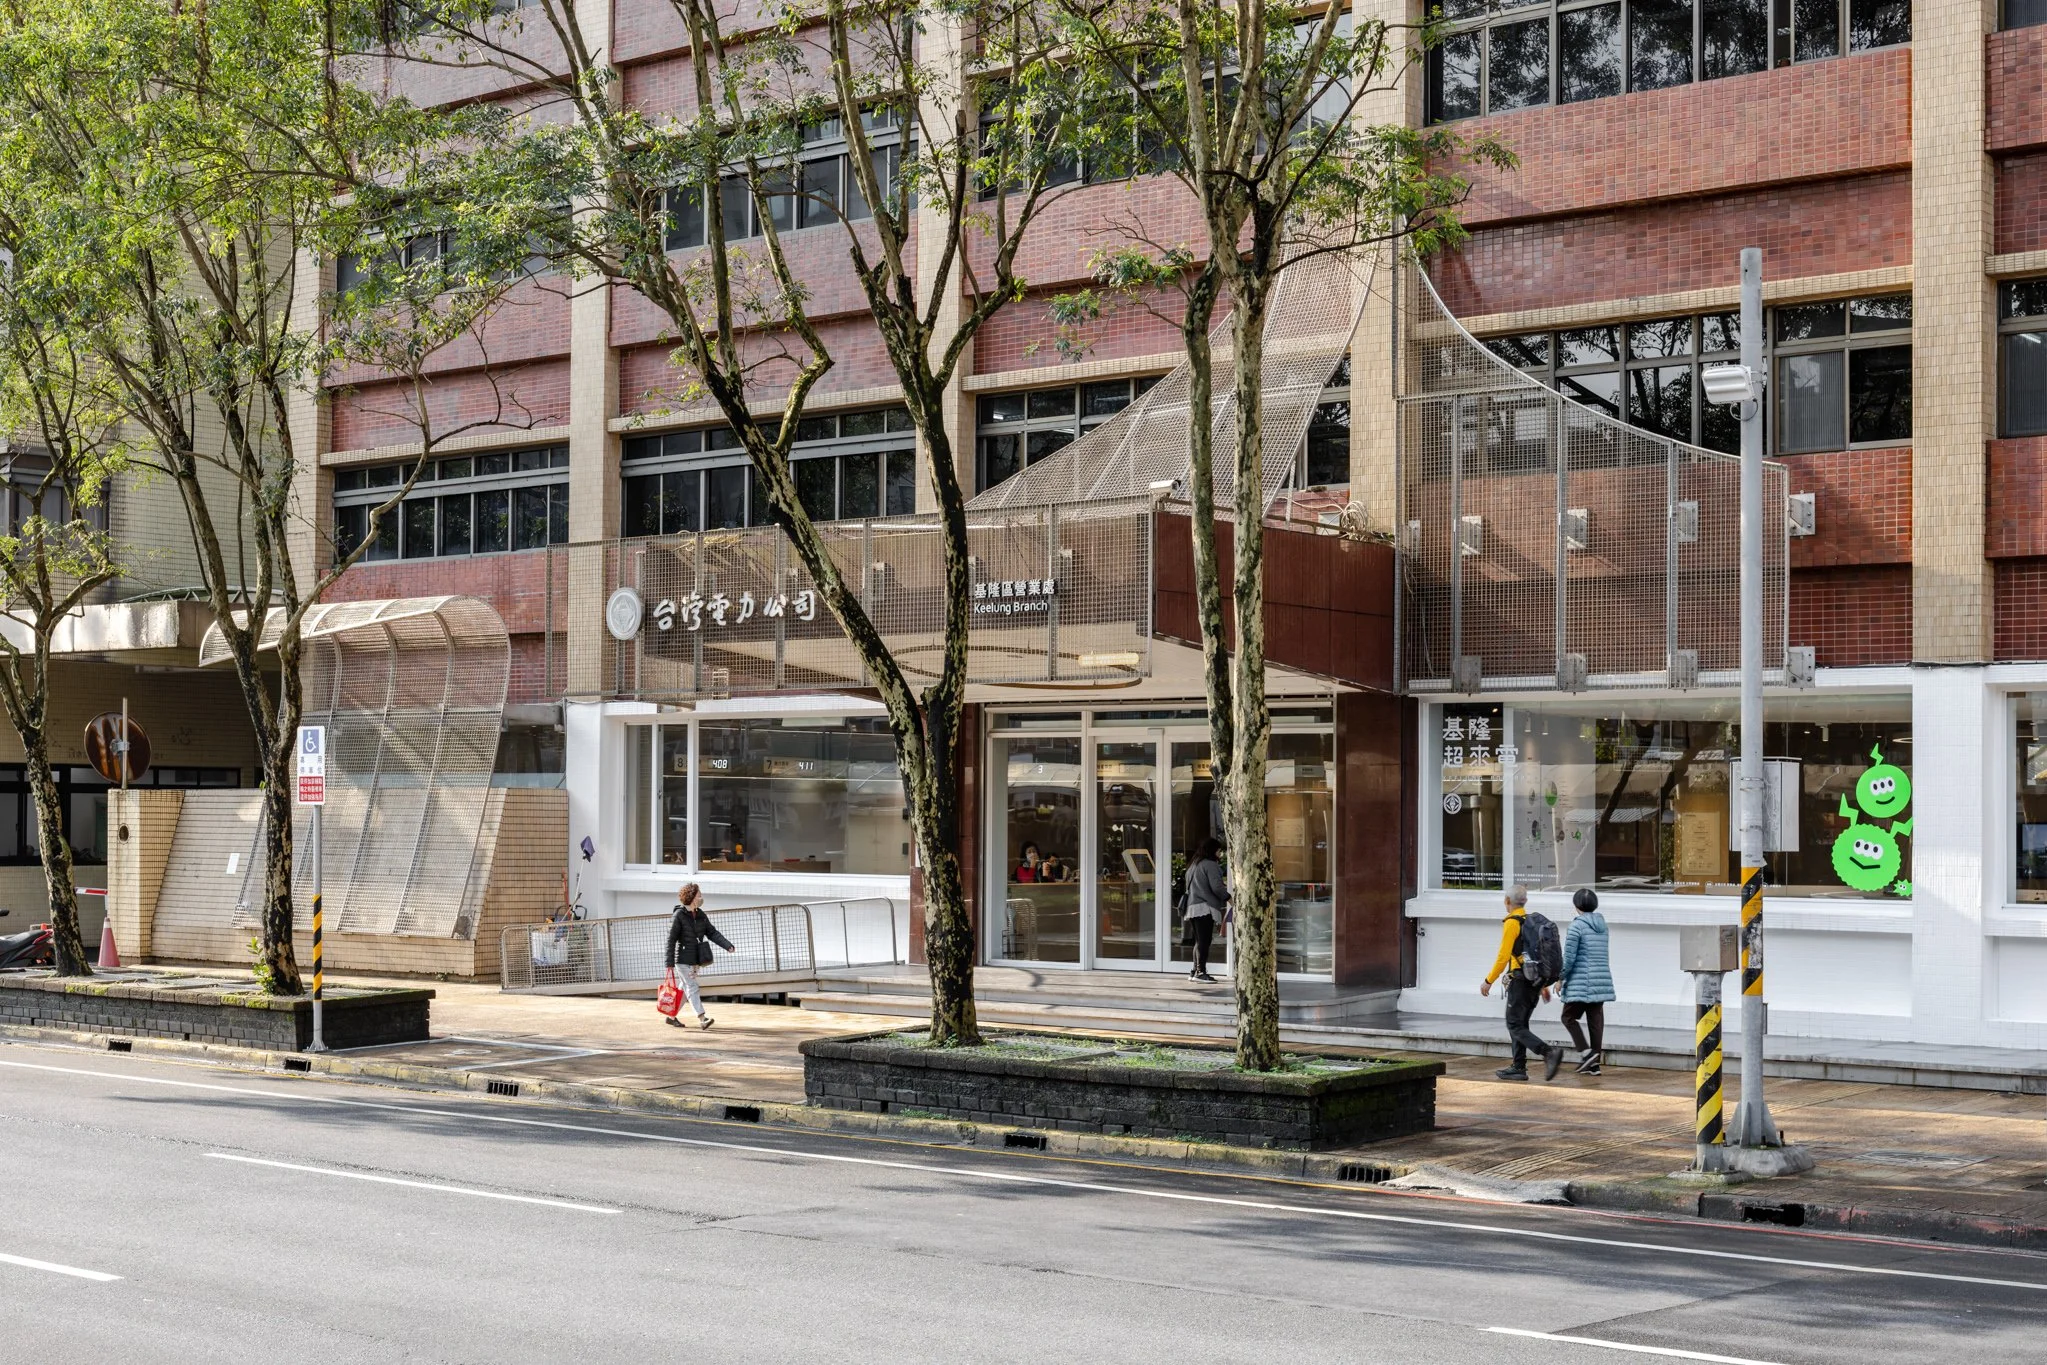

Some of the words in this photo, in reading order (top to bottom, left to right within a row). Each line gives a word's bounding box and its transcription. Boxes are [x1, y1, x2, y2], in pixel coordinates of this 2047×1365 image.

[974, 578, 1054, 598] 基隆區營業處
[653, 589, 815, 631] 台灣電力公司
[974, 602, 1011, 616] Keelung
[1013, 600, 1048, 612] Branch
[1442, 716, 1491, 741] 基隆
[712, 759, 728, 769] 408
[798, 761, 814, 770] 411
[1442, 744, 1519, 768] 超來電
